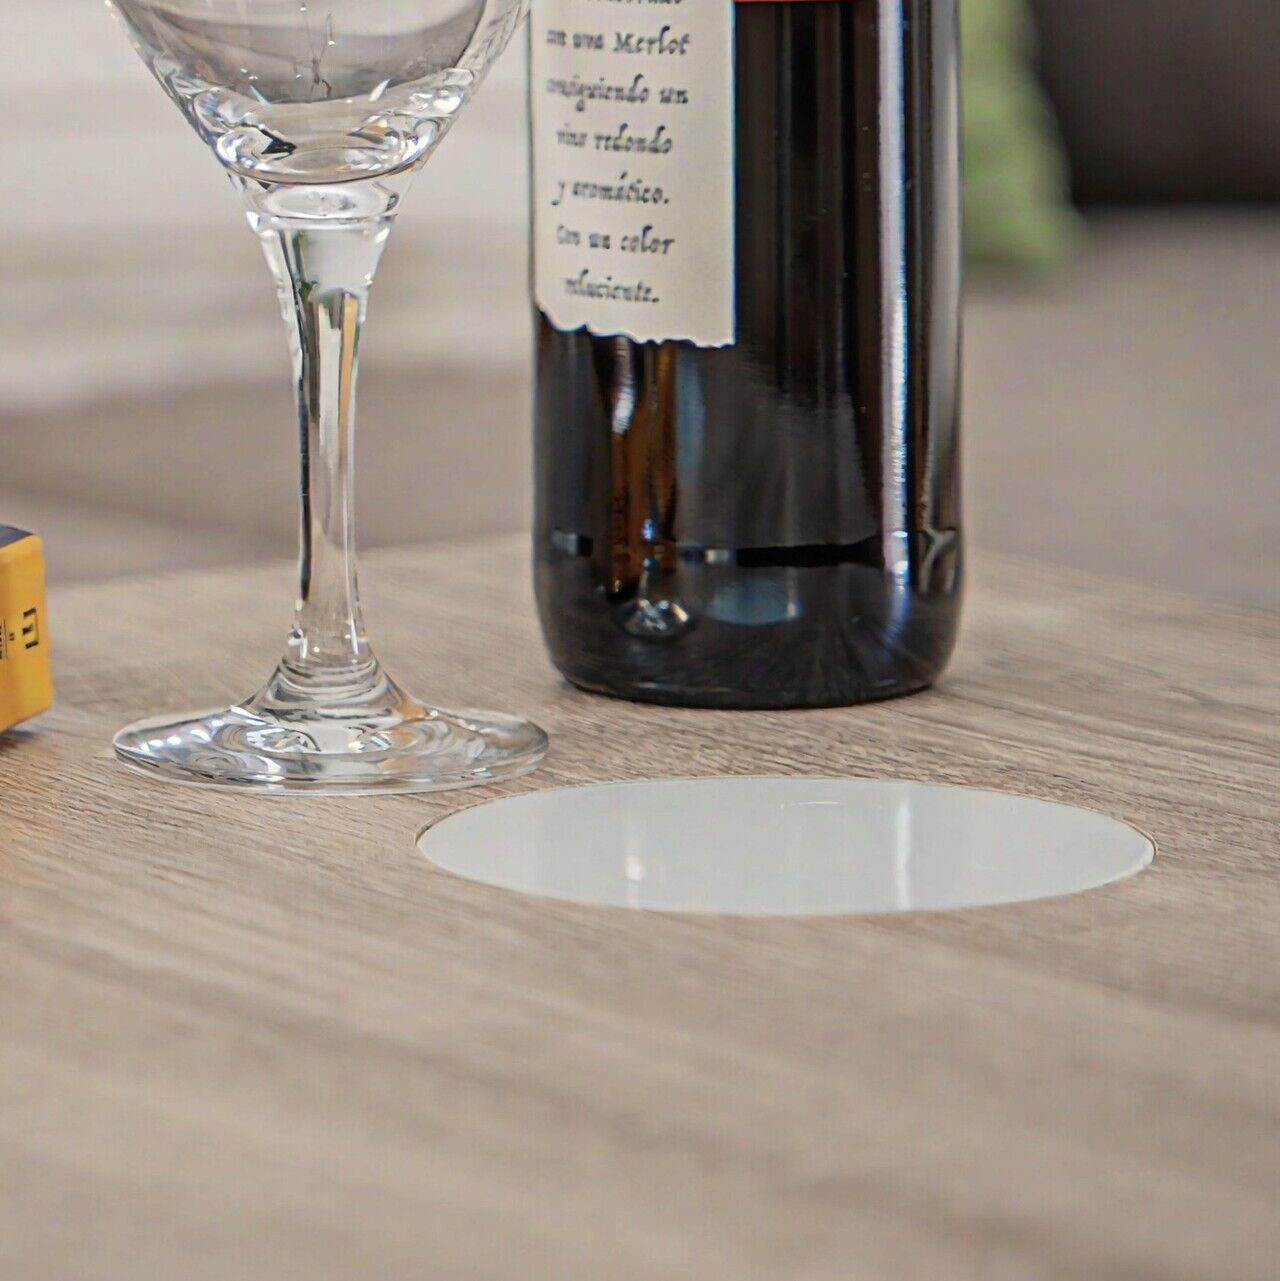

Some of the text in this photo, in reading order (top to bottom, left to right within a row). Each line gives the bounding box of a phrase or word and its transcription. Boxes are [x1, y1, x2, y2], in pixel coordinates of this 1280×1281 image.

[612, 24, 692, 56] Merlot
[659, 86, 689, 105] un
[593, 121, 673, 154] redondo
[550, 170, 671, 207] y aromático.
[620, 224, 676, 256] color
